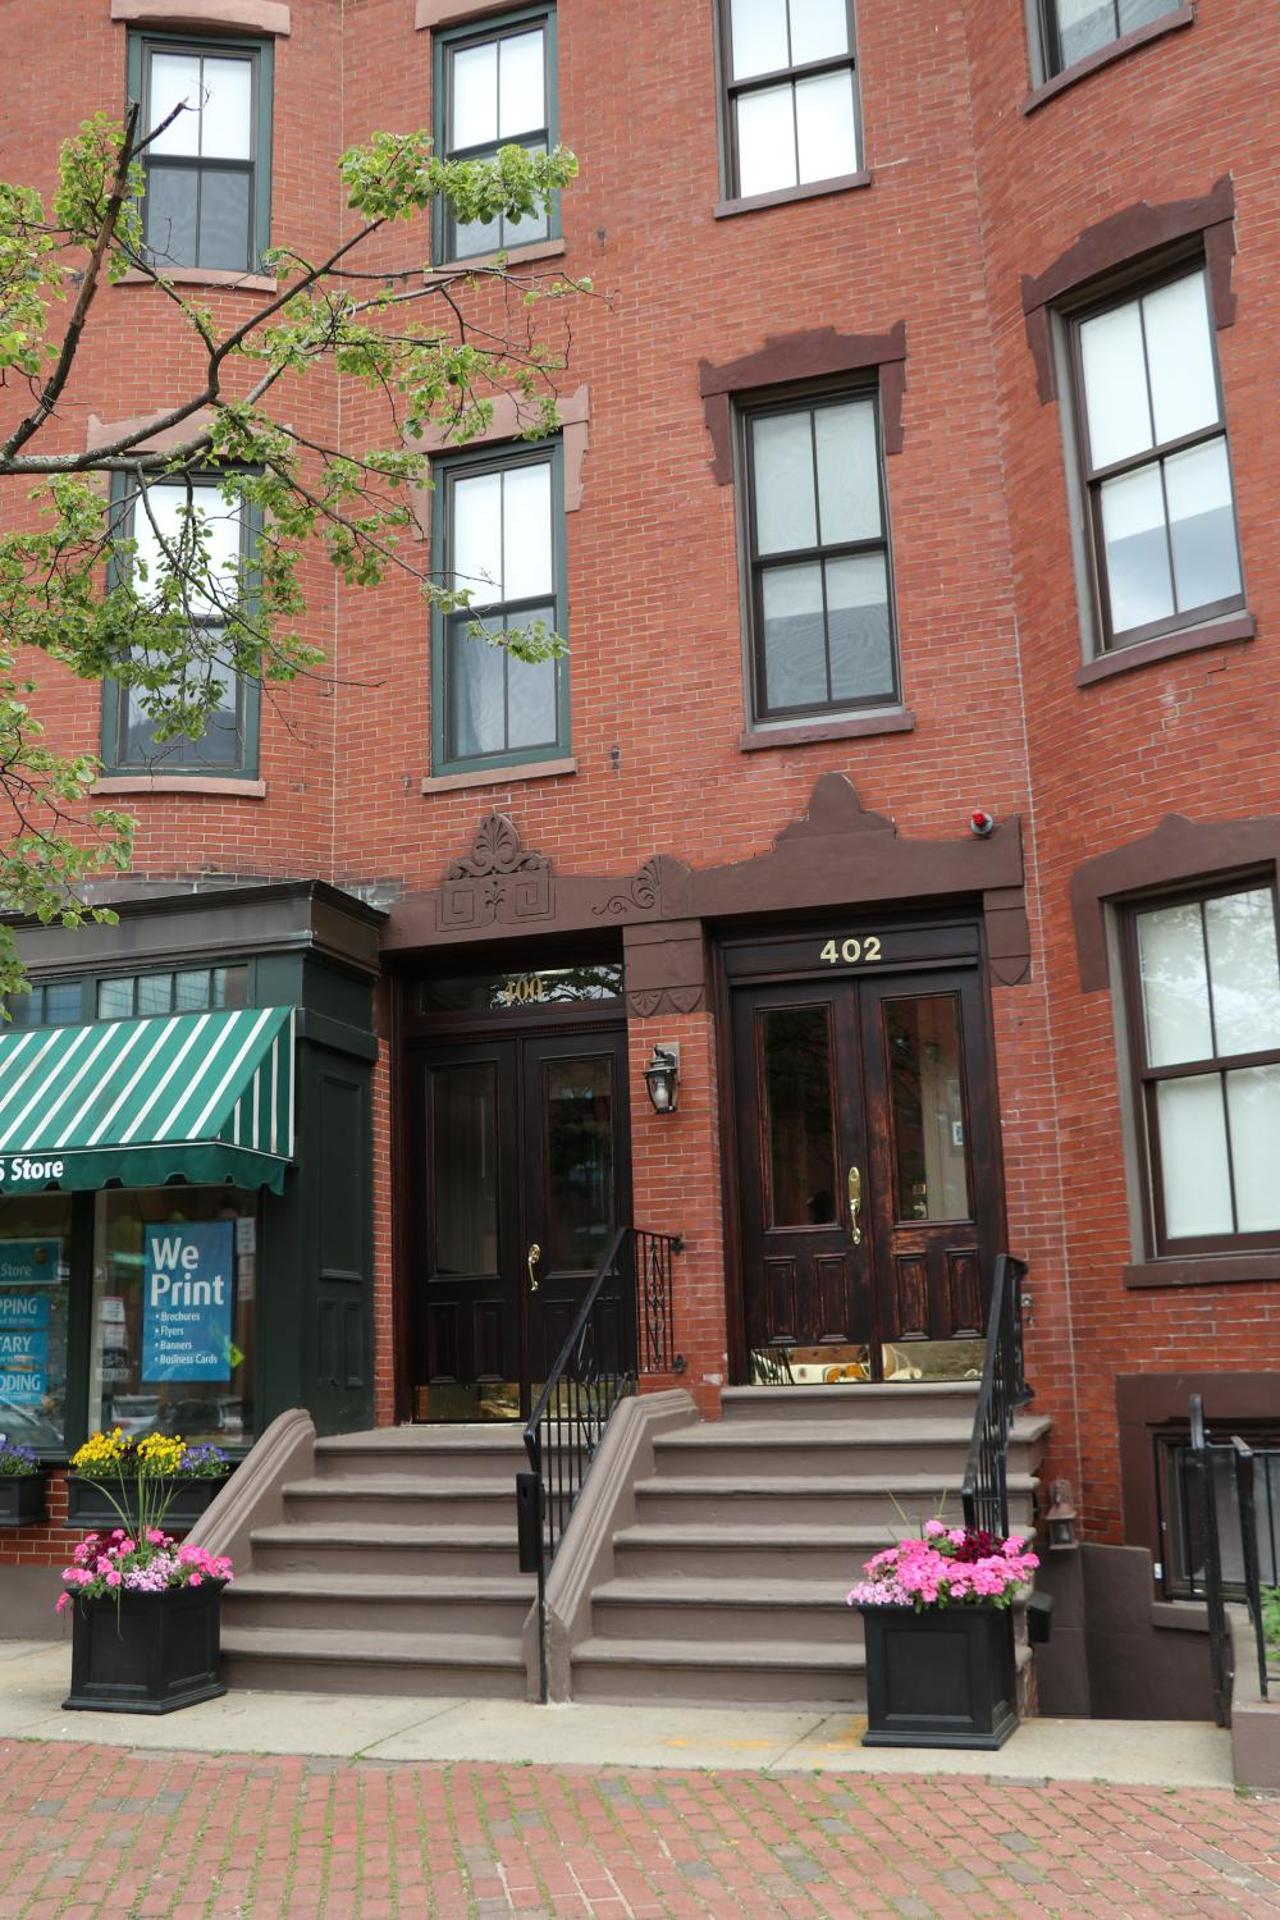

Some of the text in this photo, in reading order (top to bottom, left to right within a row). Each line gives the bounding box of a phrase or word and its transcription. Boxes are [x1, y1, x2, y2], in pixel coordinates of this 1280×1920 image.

[820, 936, 882, 964] 402
[504, 978, 544, 1002] 400
[11, 1157, 64, 1181] Store
[151, 1237, 200, 1271] We
[150, 1272, 225, 1307] Print
[0, 1297, 38, 1314] PING
[160, 1311, 201, 1321] Brochures
[160, 1325, 184, 1337] Flyers
[0, 1335, 32, 1353] ARY
[159, 1340, 192, 1350] Banners
[159, 1353, 218, 1364] Business Cards
